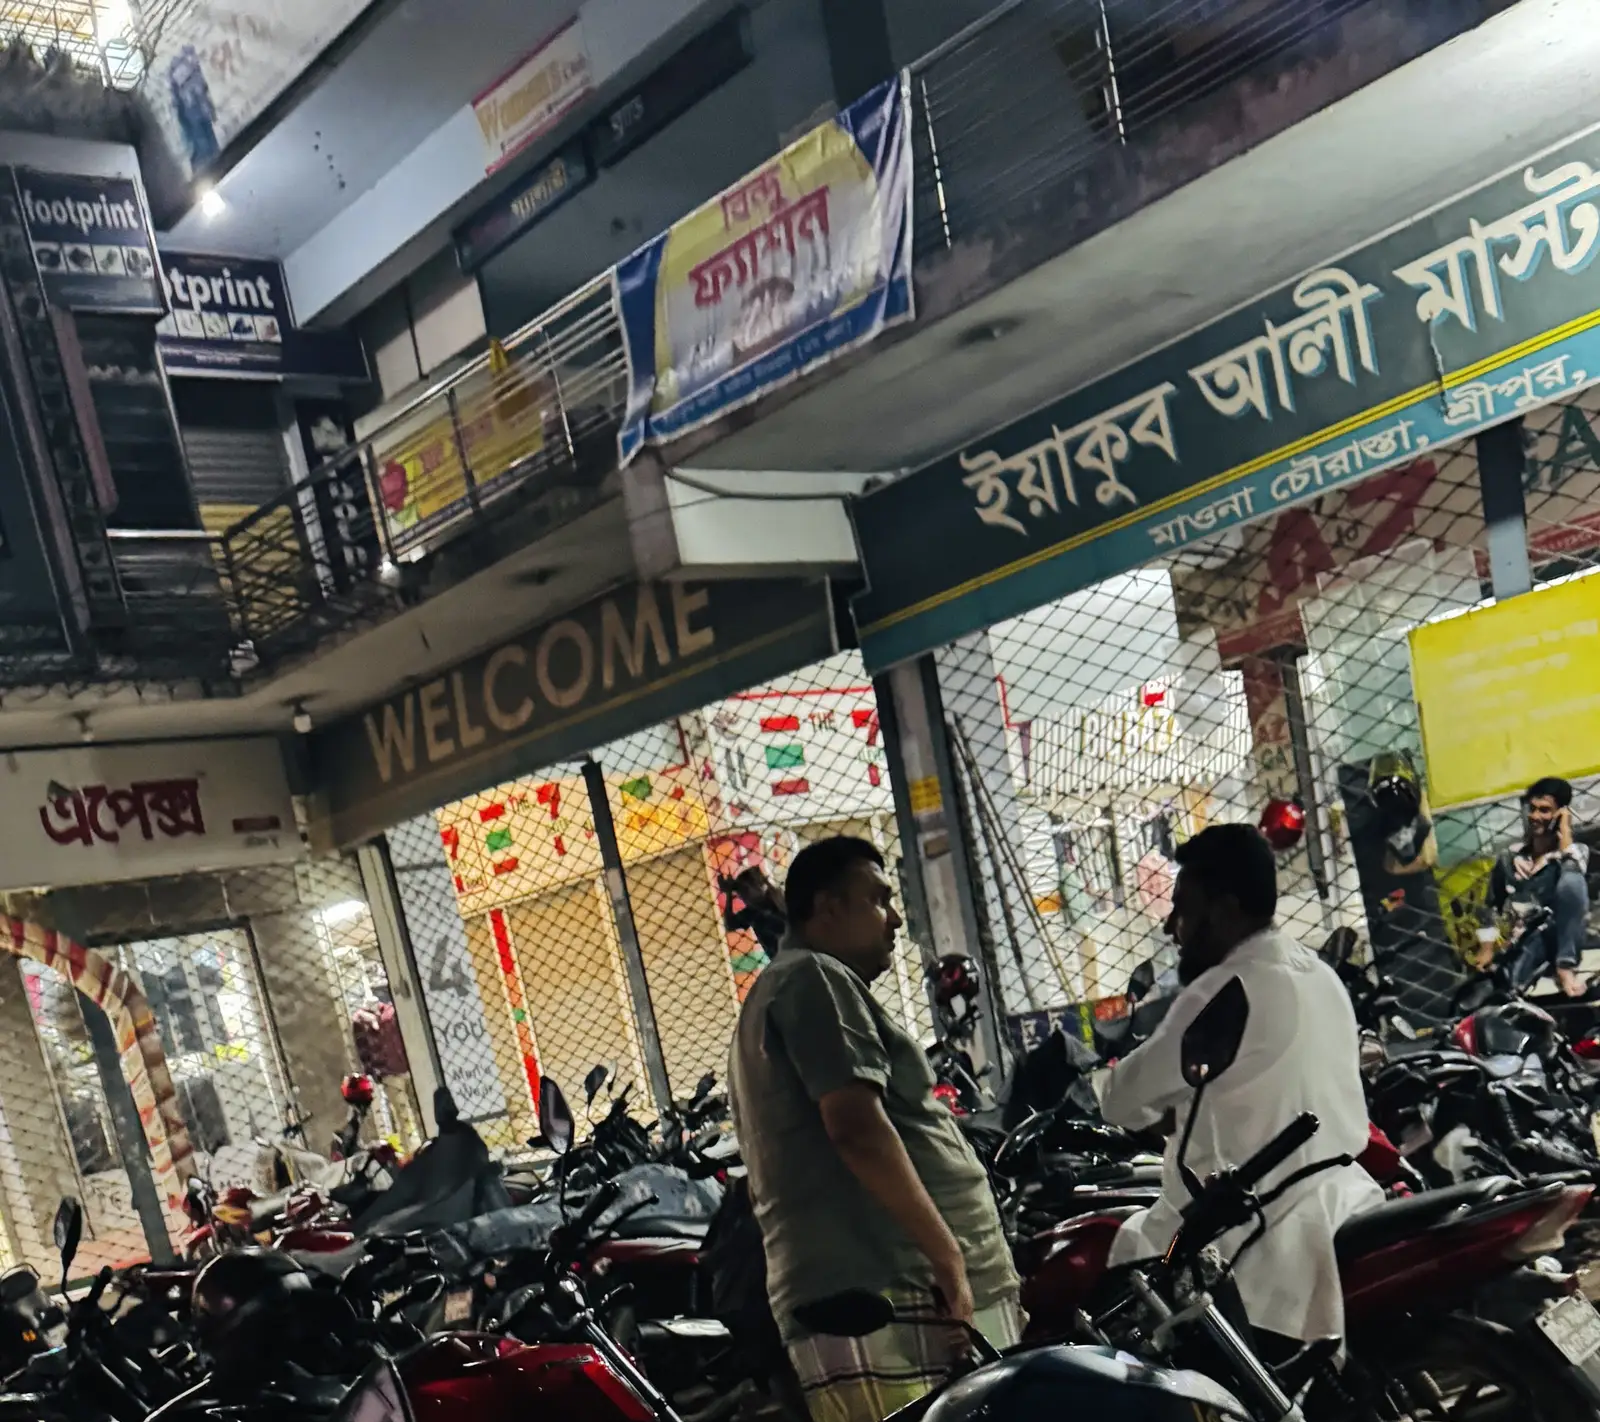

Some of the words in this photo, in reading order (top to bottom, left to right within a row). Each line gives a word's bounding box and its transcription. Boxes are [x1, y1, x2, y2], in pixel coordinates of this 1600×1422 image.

[24, 190, 139, 236] footprint
[960, 382, 1177, 536] ইয়াকুব
[1188, 268, 1384, 421] আলী
[1148, 486, 1257, 546] মাওনা
[1443, 354, 1587, 426] শ্রীপুর,
[364, 580, 715, 783] WELCOME
[39, 779, 206, 846] এপেক্স
